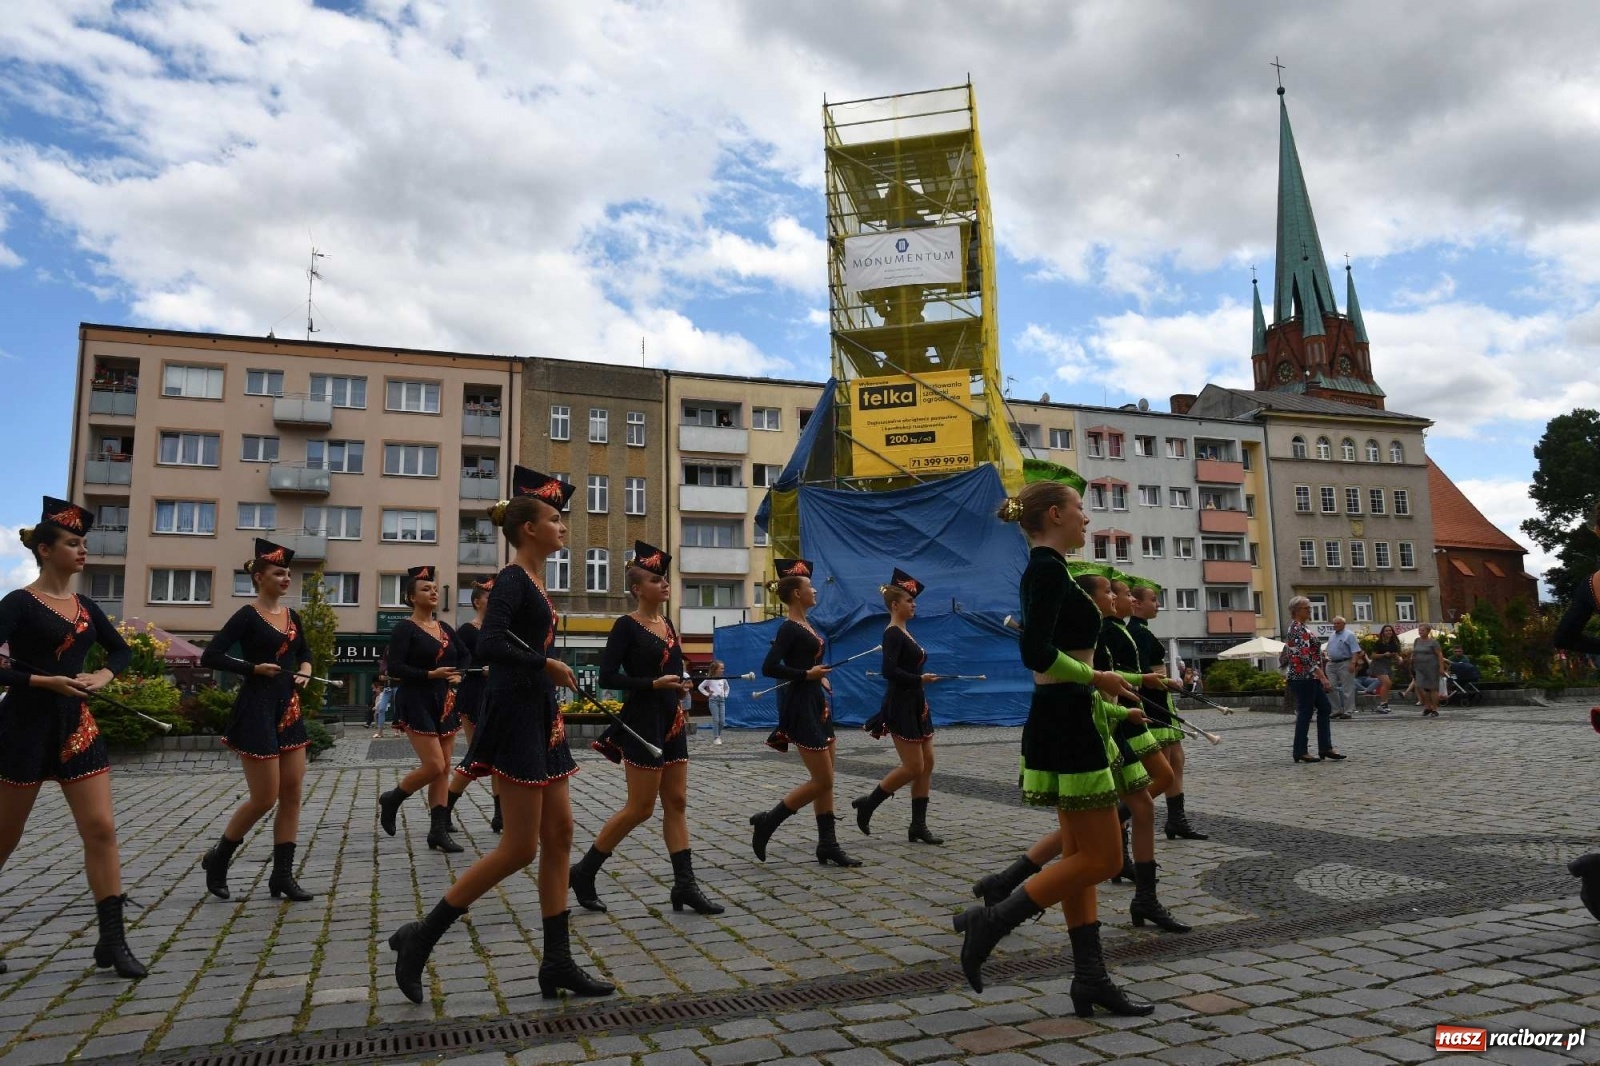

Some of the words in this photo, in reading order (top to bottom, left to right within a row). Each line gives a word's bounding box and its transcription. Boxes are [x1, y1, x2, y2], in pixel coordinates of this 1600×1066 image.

[853, 250, 954, 269] MONUMENTUM
[863, 389, 913, 406] telka
[889, 434, 909, 444] 200
[911, 459, 921, 467] 71
[924, 458, 942, 466] 399
[943, 456, 955, 464] 99
[957, 455, 969, 463] 99
[330, 646, 381, 658] UBIL
